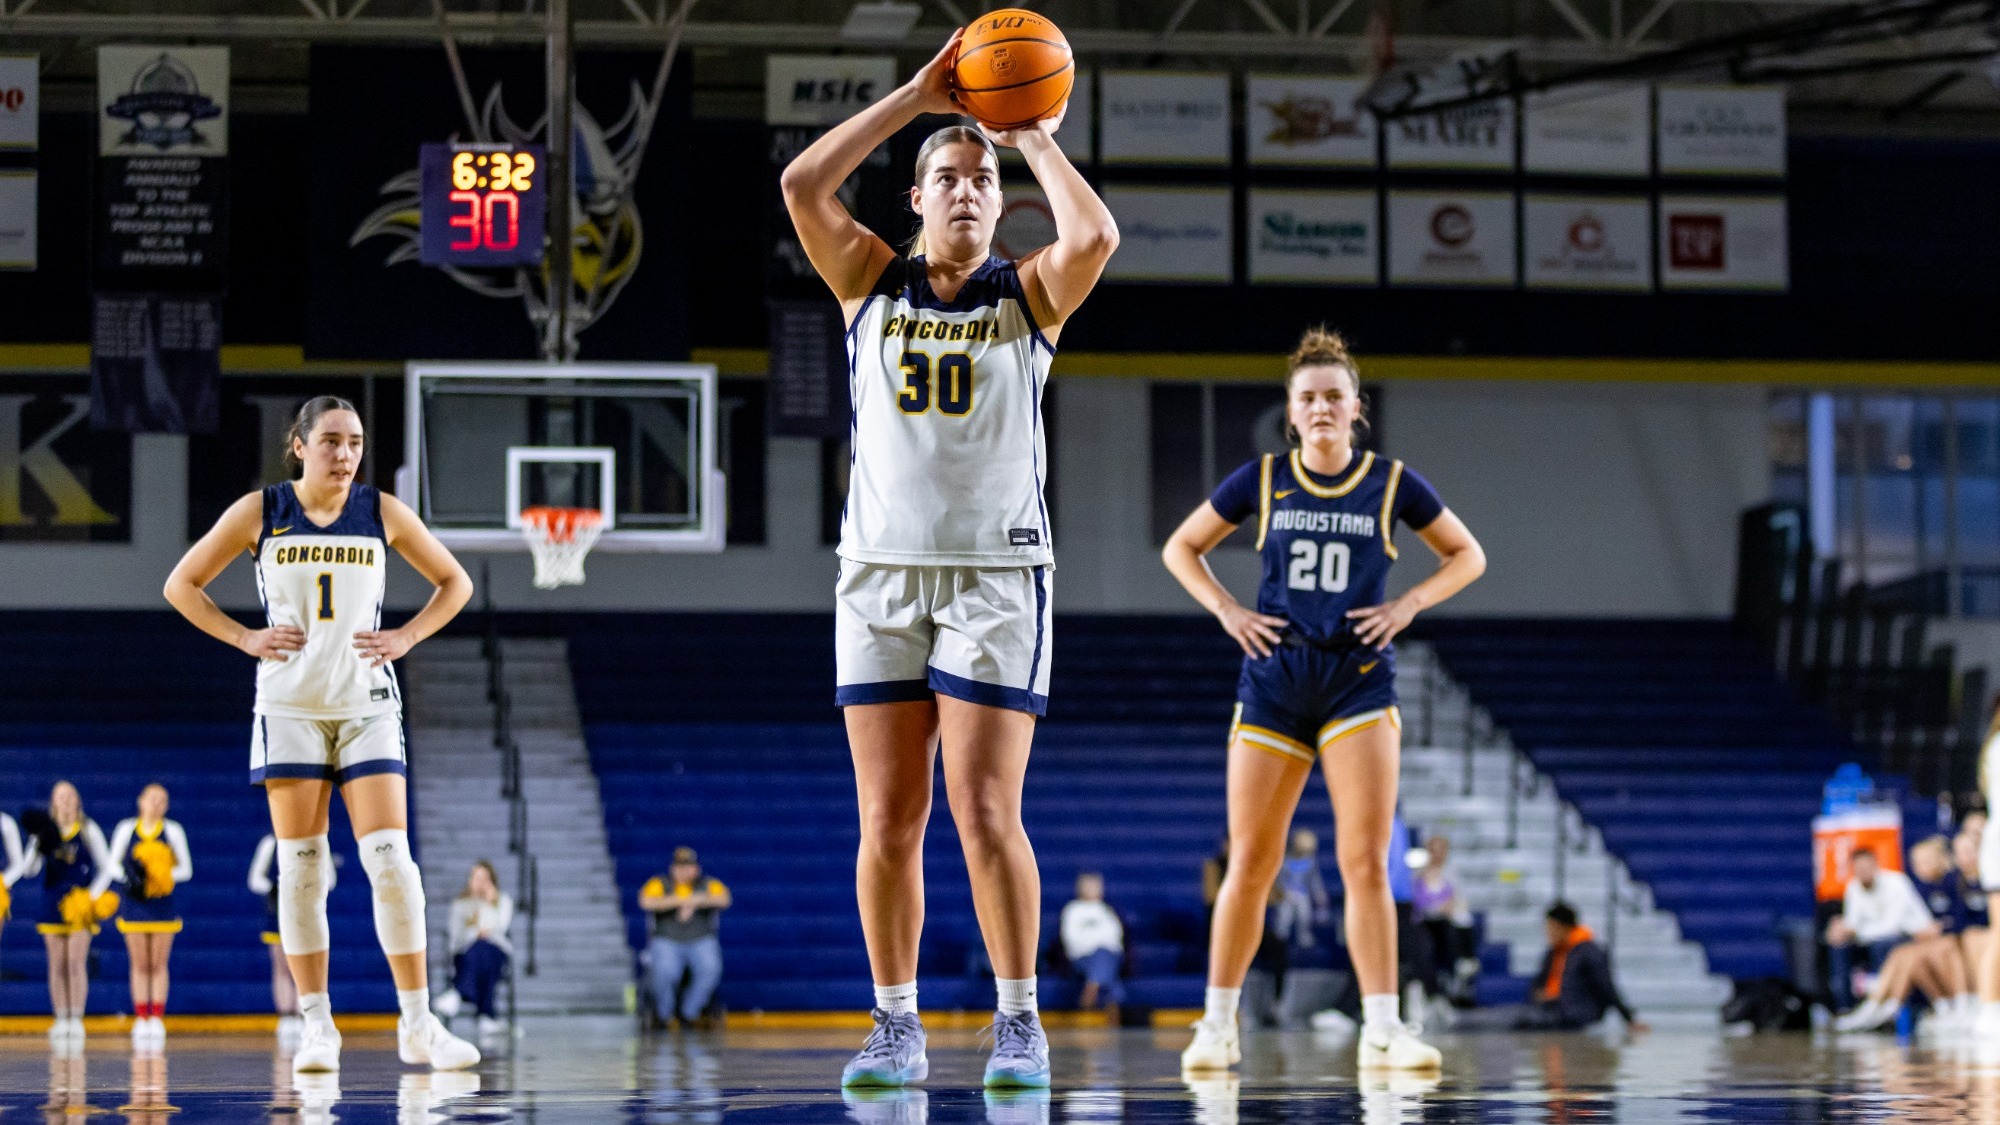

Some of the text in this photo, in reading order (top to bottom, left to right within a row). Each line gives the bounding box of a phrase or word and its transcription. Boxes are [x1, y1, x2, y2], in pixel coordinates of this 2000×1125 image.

[976, 17, 1025, 36] EVO
[794, 79, 877, 103] NSIC
[452, 152, 535, 191] 6:32
[449, 191, 519, 251] 30
[883, 313, 1000, 342] CONCORDIA
[896, 350, 975, 417] 30
[1272, 509, 1375, 538] AUGUSTANA
[276, 546, 375, 567] CONCORDIA
[1288, 538, 1350, 593] 20
[316, 572, 335, 621] 1
